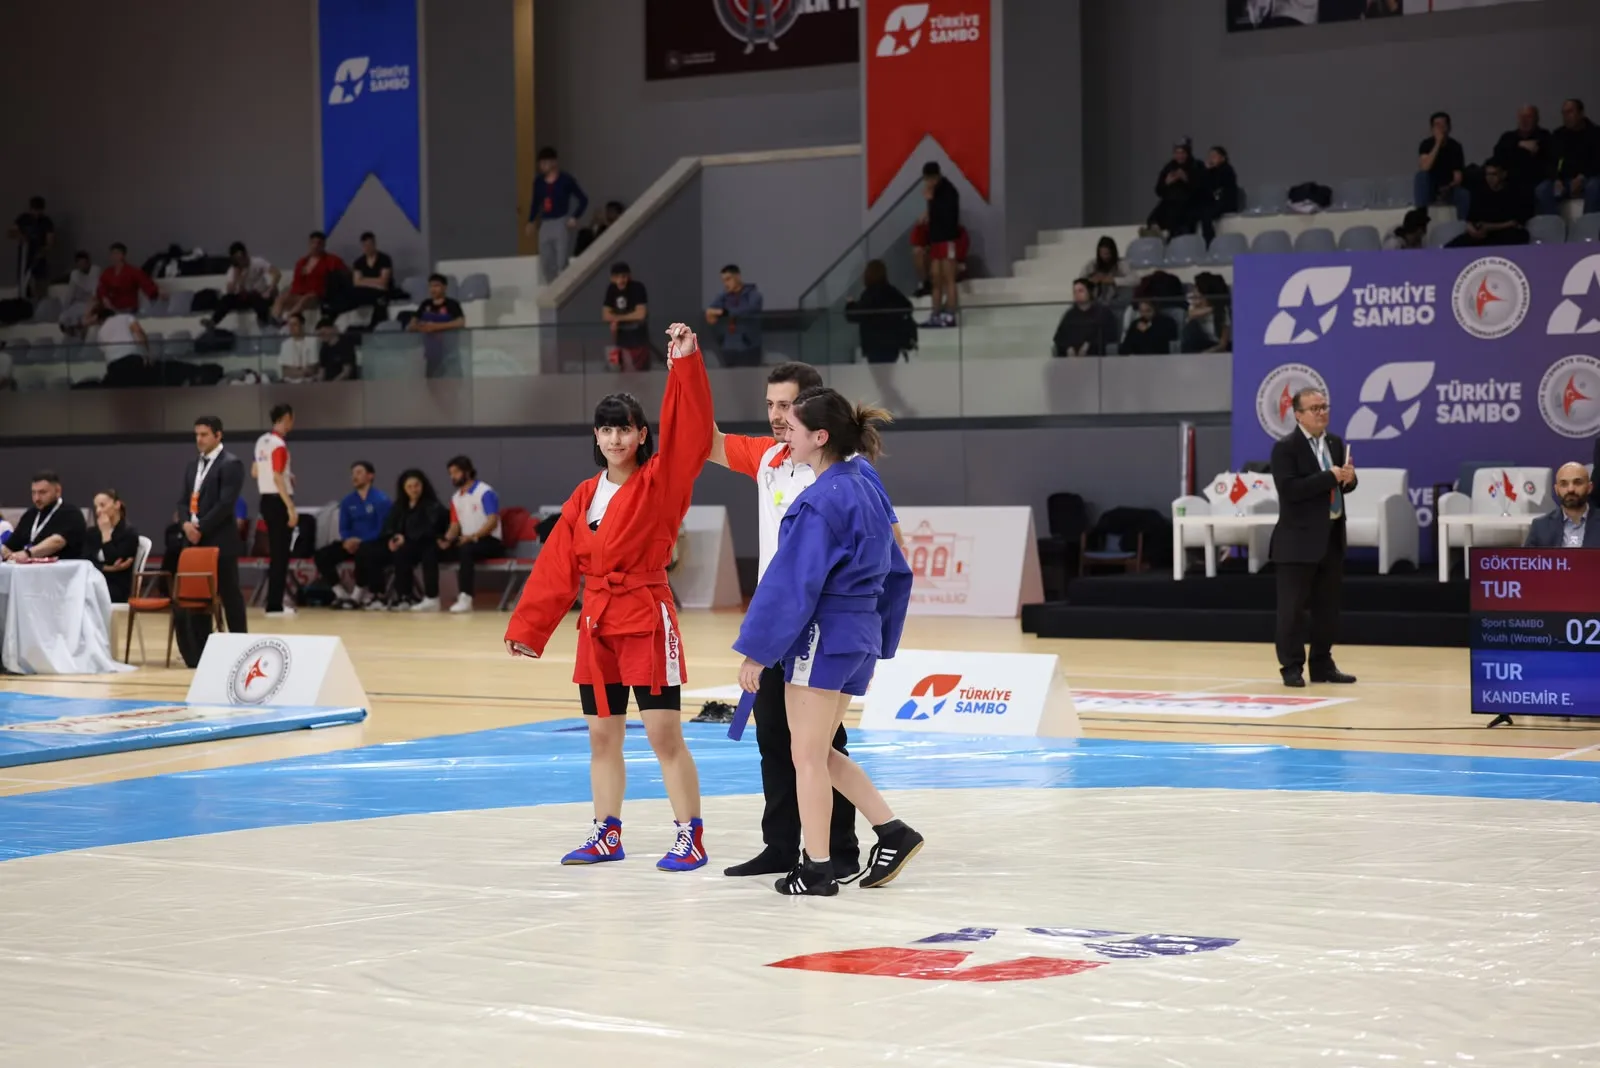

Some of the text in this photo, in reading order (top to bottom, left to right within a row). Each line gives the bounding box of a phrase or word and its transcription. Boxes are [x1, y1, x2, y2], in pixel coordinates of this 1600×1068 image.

[929, 12, 979, 28] TÜRKİYE
[929, 28, 979, 43] SAMBO
[370, 77, 409, 92] SAMBO
[1352, 281, 1436, 306] TÜRKİYE
[1352, 305, 1435, 327] SAMBO
[1435, 378, 1522, 402] TÜRKİYE
[1436, 402, 1521, 424] SAMBO
[1480, 555, 1572, 571] GÖKTEKİN H.
[1480, 580, 1522, 599] TUR
[1481, 618, 1544, 630] Sport SAMBO
[1481, 633, 1508, 643] Youth
[1510, 633, 1552, 646] (Women)
[1481, 662, 1523, 680] TUR
[959, 687, 1012, 701] TÜRKİYE
[1482, 690, 1575, 706] KANDEMİR E.
[954, 701, 1007, 715] SAMBO
